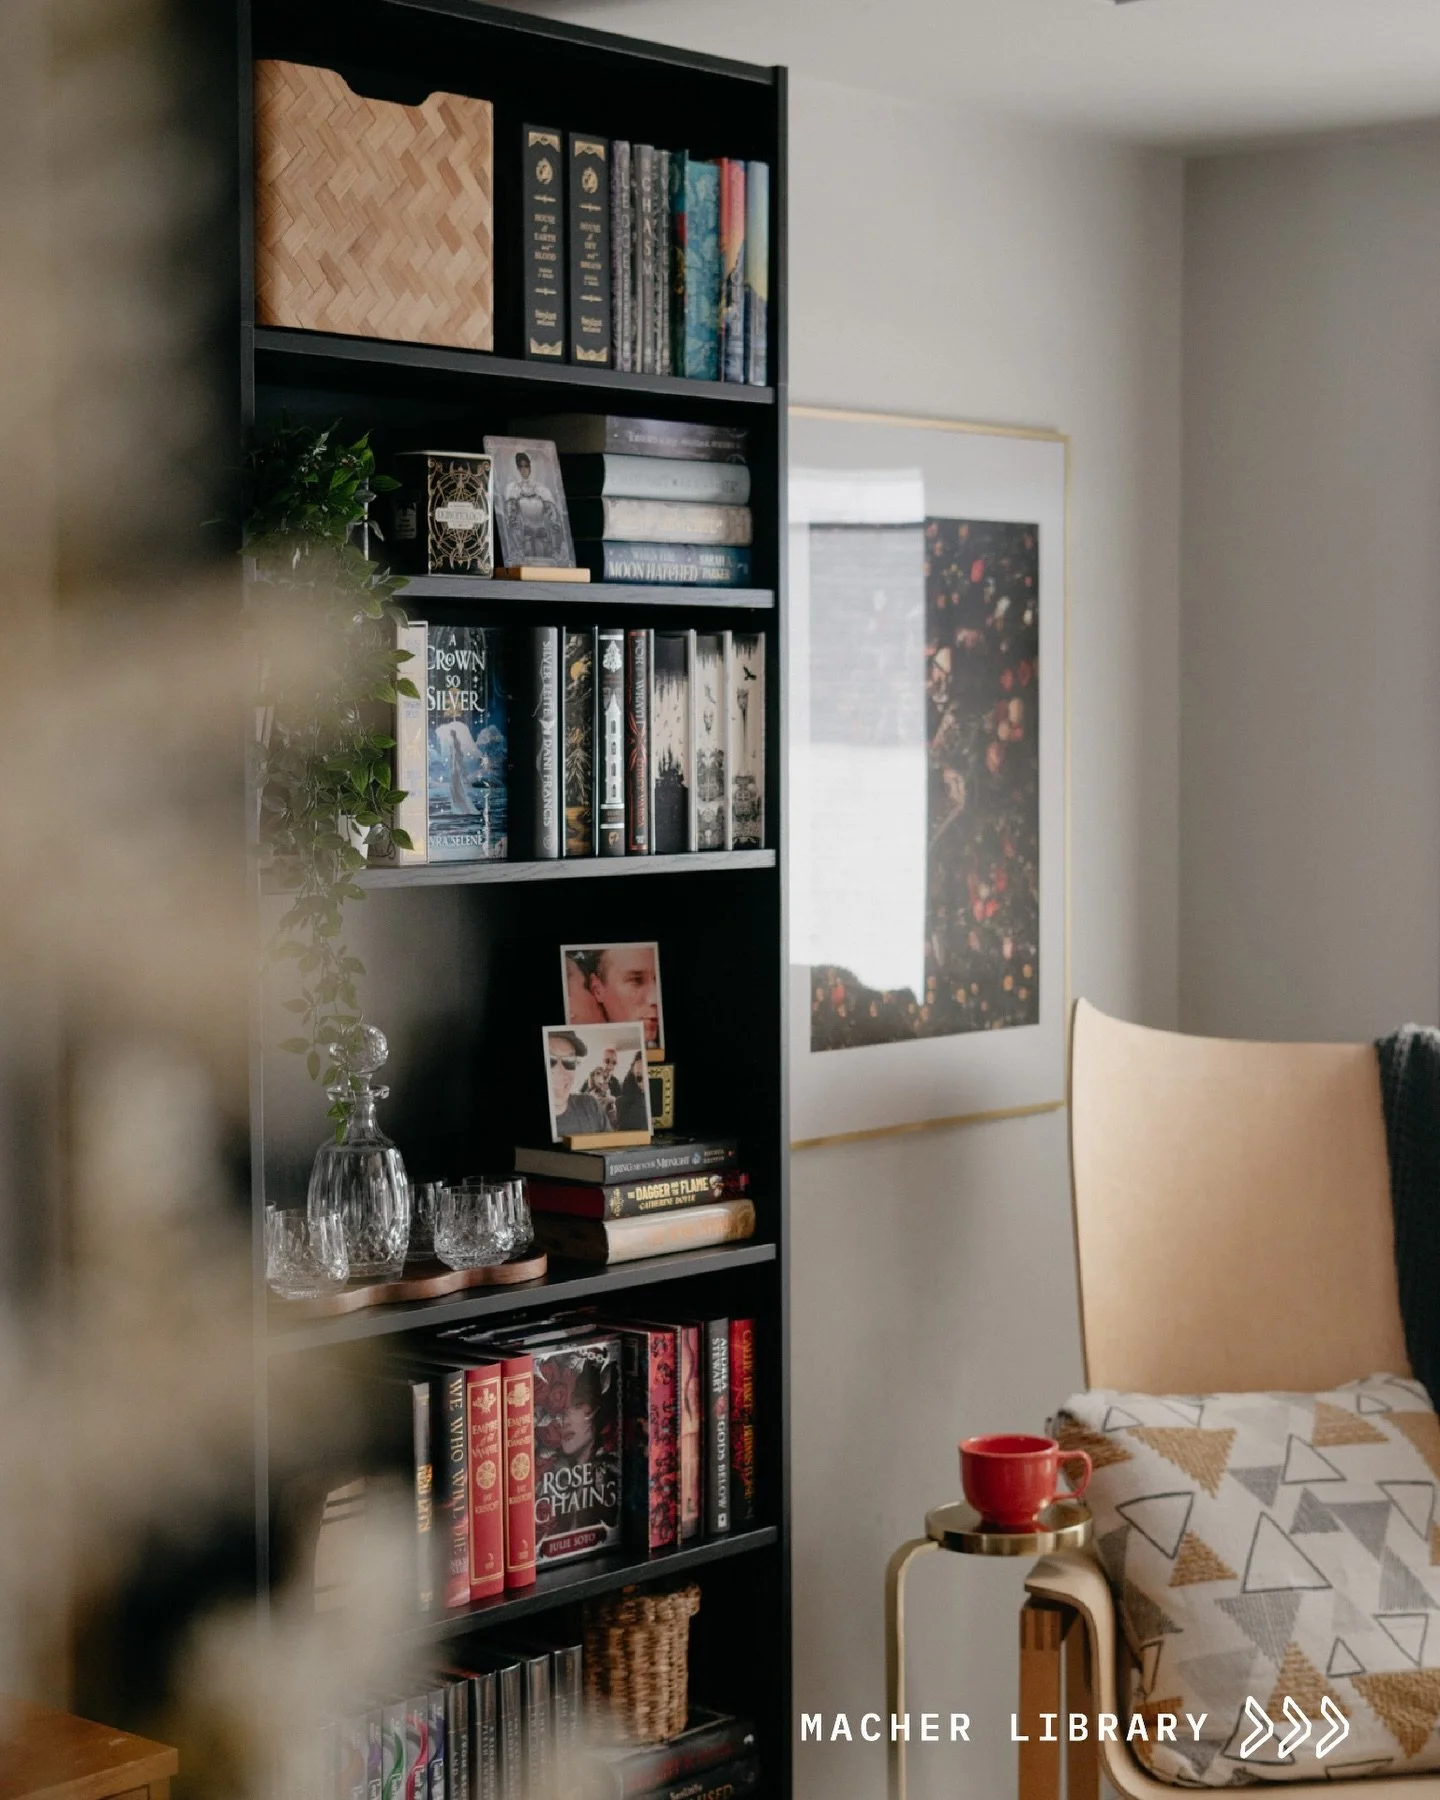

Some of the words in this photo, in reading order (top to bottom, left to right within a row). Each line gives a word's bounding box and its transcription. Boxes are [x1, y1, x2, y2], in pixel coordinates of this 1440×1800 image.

[641, 176, 653, 276] CHASM
[608, 561, 645, 578] MOON
[646, 562, 698, 582] HATCHED
[449, 634, 457, 646] A
[427, 645, 486, 672] CROWN
[542, 640, 553, 679] SILVER
[446, 675, 462, 688] SO
[427, 686, 486, 712] SILVER
[542, 739, 553, 771] DANI
[542, 774, 554, 828] FRANCIS
[429, 835, 449, 848] YRA
[635, 1183, 671, 1201] DAGGER
[680, 1176, 709, 1194] FLAME
[639, 1197, 673, 1211] CATHERINE
[711, 1337, 721, 1393] STEWART
[720, 1337, 729, 1390] ANDREA
[449, 1377, 464, 1412] WE
[472, 1420, 499, 1435] EMPIRE
[507, 1413, 531, 1427] EMPIRE
[450, 1416, 464, 1462] WHO
[717, 1421, 726, 1461] GODS
[451, 1468, 466, 1520] WILL
[543, 1462, 594, 1498] ROSE
[717, 1464, 727, 1509] BELOW
[535, 1481, 617, 1523] CHAINS
[453, 1524, 467, 1556] DIE
[548, 1538, 571, 1553] JULIE
[574, 1532, 597, 1547] SOTO
